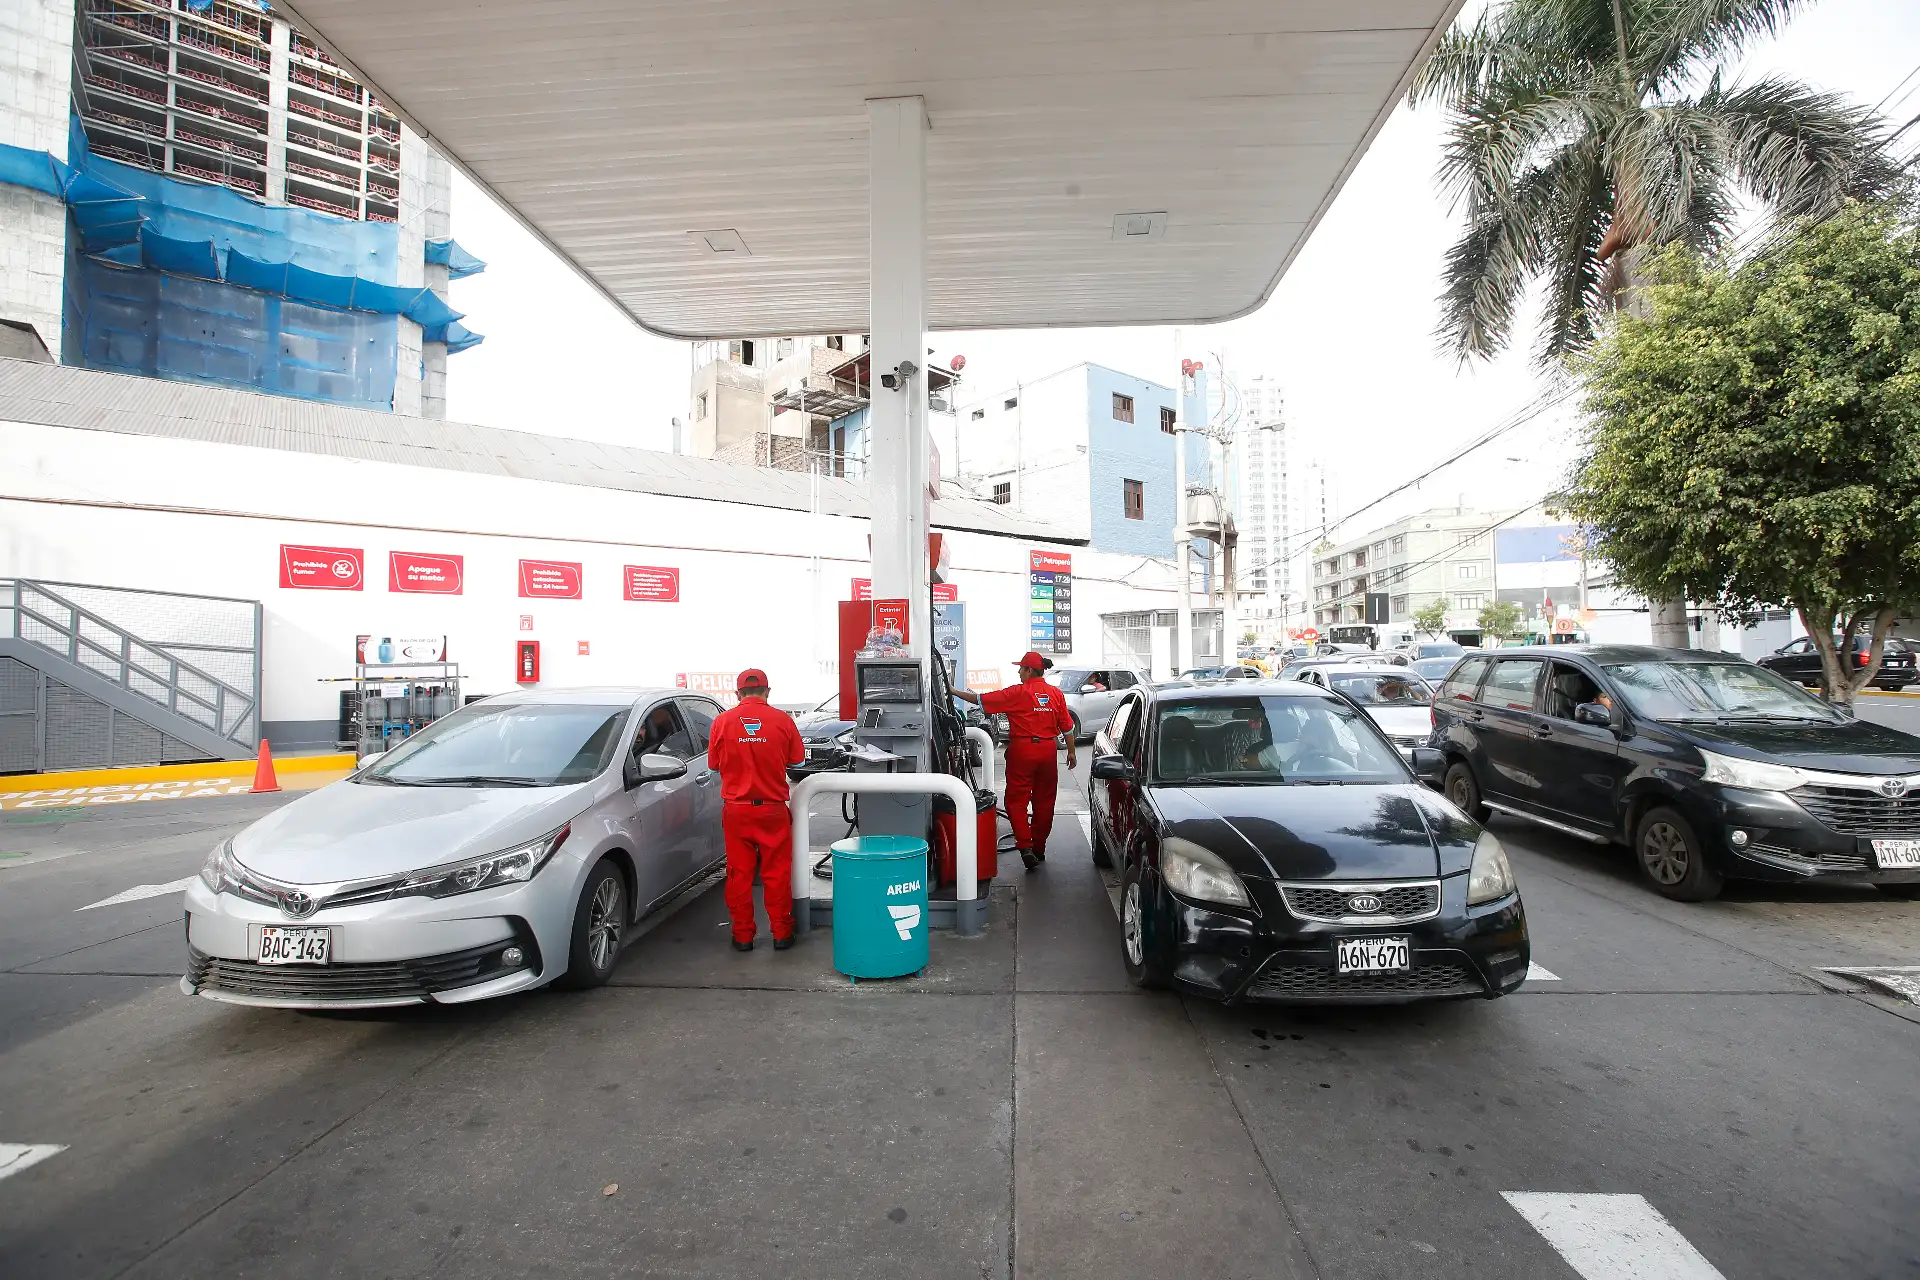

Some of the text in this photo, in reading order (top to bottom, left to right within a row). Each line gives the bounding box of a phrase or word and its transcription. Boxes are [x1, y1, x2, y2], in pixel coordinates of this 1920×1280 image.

[293, 560, 328, 569] Prohibido
[1043, 556, 1071, 566] Petroperú
[407, 565, 441, 575] Apague
[1031, 573, 1038, 583] G
[1031, 587, 1038, 597] G
[1056, 616, 1070, 624] 0.00
[934, 625, 961, 633] ESUELTO
[1057, 630, 1070, 638] 0.00
[1057, 642, 1071, 650] 0.00
[691, 674, 738, 691] PELIG
[1879, 847, 1920, 863] ATK-60
[886, 879, 921, 896] ARENA
[1353, 899, 1377, 909] KIA
[261, 936, 326, 961] BAC-143
[1339, 945, 1408, 969] A6N-670
